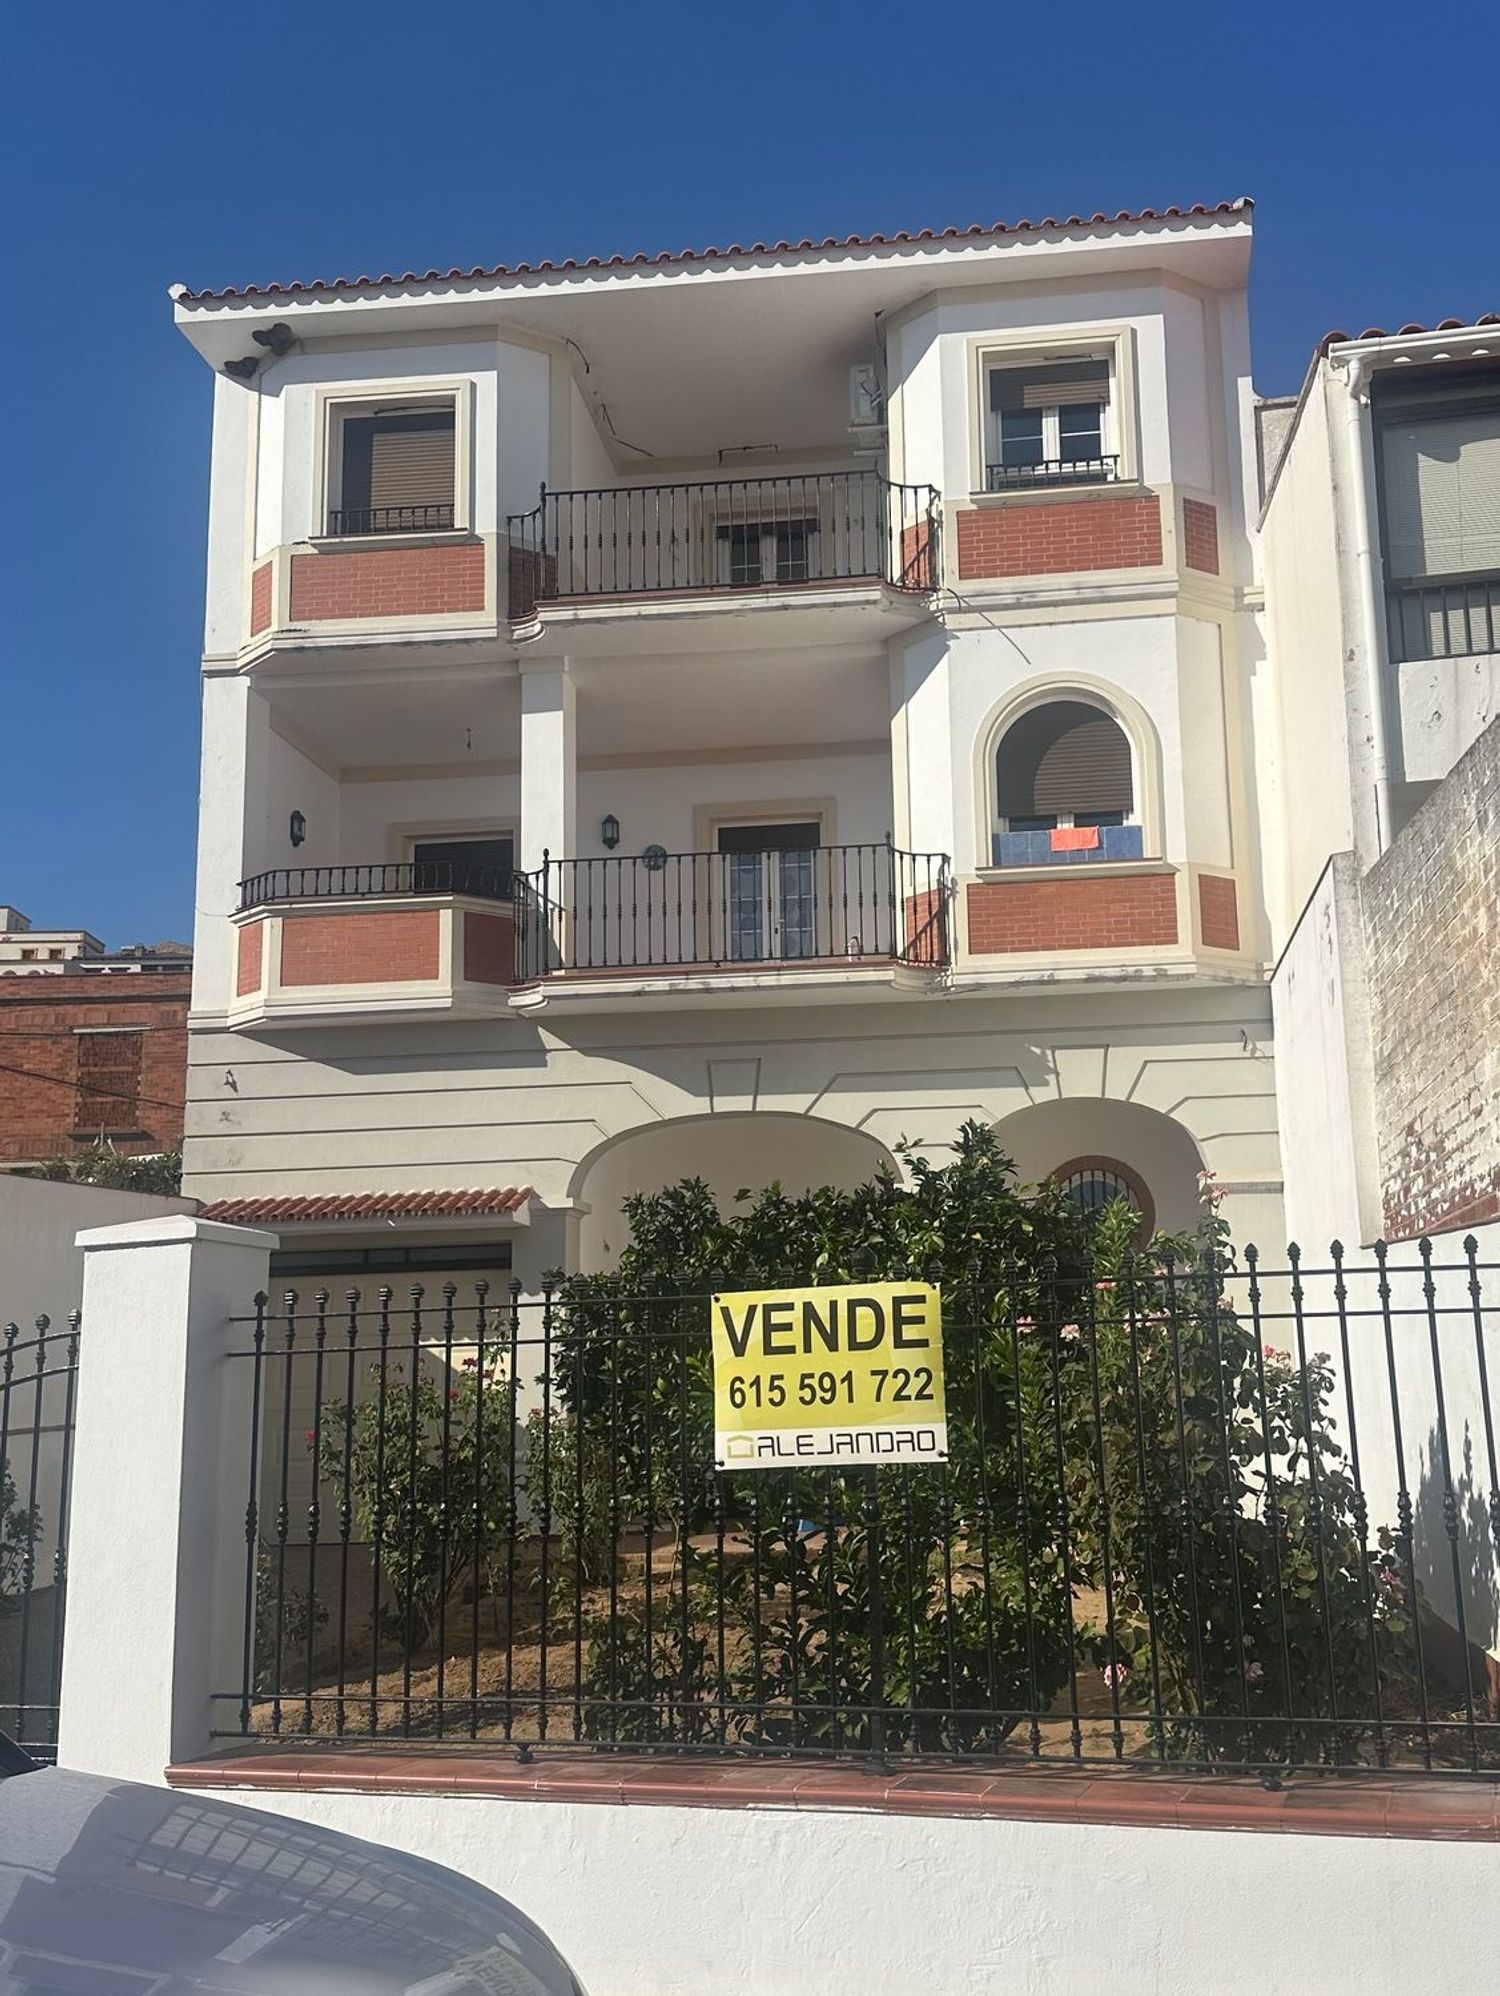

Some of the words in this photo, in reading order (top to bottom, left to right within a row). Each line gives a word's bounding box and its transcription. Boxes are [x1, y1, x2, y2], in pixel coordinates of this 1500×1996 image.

[720, 1295, 929, 1358] VENDE
[729, 1374, 787, 1409] 615
[798, 1370, 855, 1406] 591
[870, 1366, 935, 1403] 722
[757, 1430, 936, 1458] ALEJANDRO
